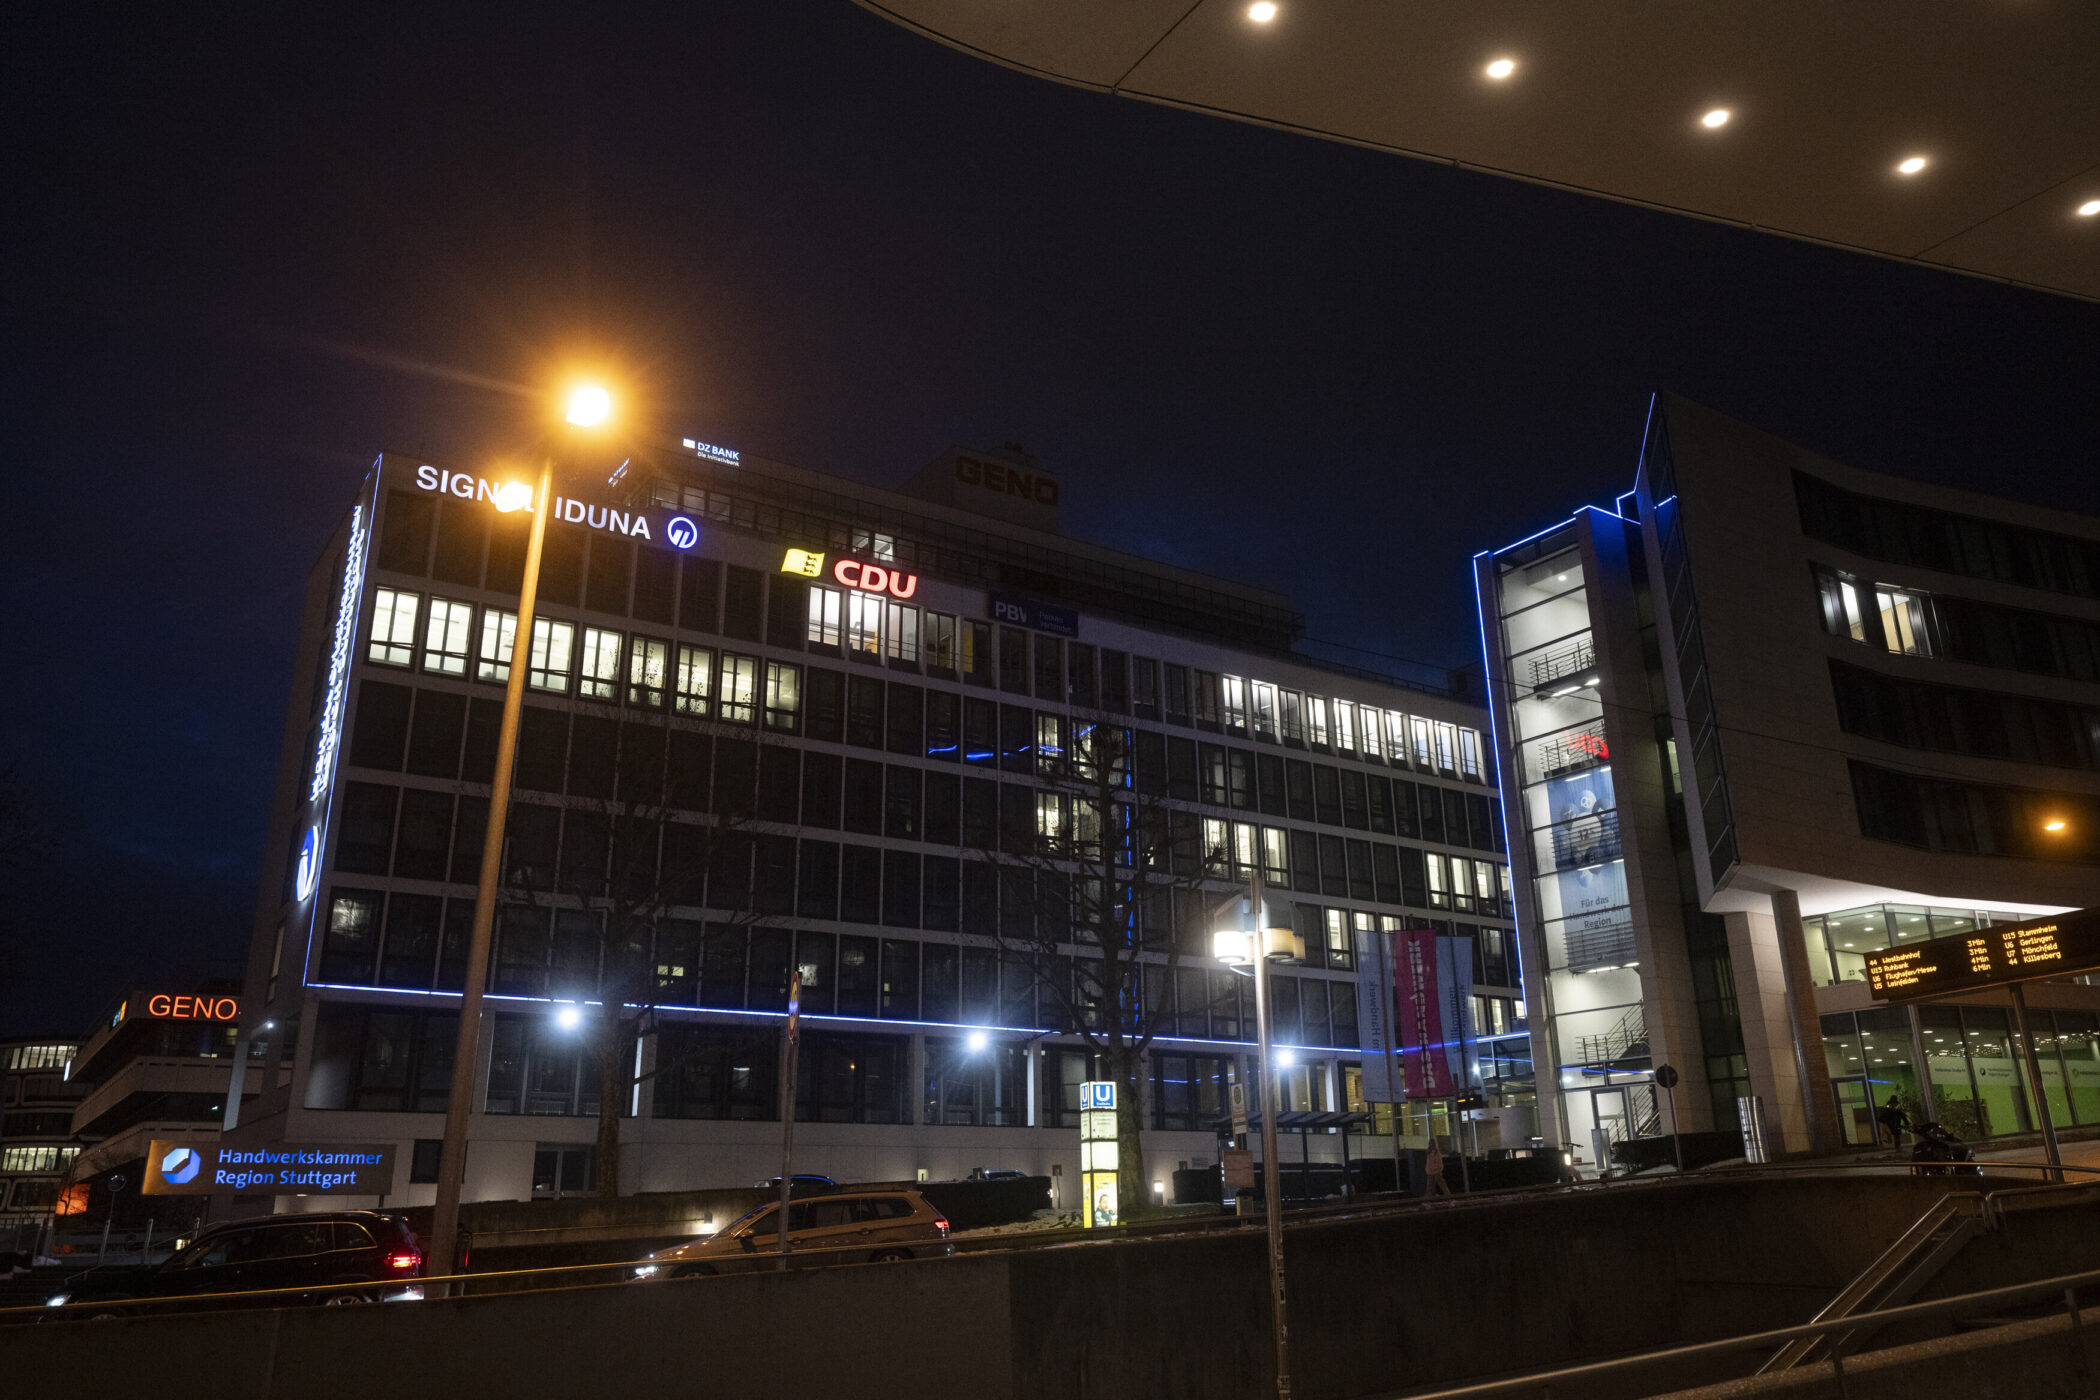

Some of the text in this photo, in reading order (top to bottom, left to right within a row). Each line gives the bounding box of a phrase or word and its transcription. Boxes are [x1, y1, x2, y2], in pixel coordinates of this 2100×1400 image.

[697, 442, 740, 460] DZ BANK
[955, 456, 1060, 506] GENO
[554, 497, 651, 540] IDUNA
[833, 559, 917, 599] CDU
[1580, 896, 1609, 908] Für das
[1584, 917, 1612, 929] Region
[2002, 924, 2058, 940] U15 Stammheim
[2004, 934, 2054, 949] U6 Gerlingen
[1881, 950, 1921, 964] Westbahnhof
[2006, 942, 2058, 958] U7 Mönchfeld
[2008, 951, 2062, 966] 44 Killesberg
[1883, 962, 1909, 972] Ruhbank
[1887, 977, 1919, 988] Leinfelden
[1095, 1086, 1110, 1101] U
[218, 1149, 382, 1166] Handwerkskammer
[215, 1170, 357, 1189] Region Stuttgart
